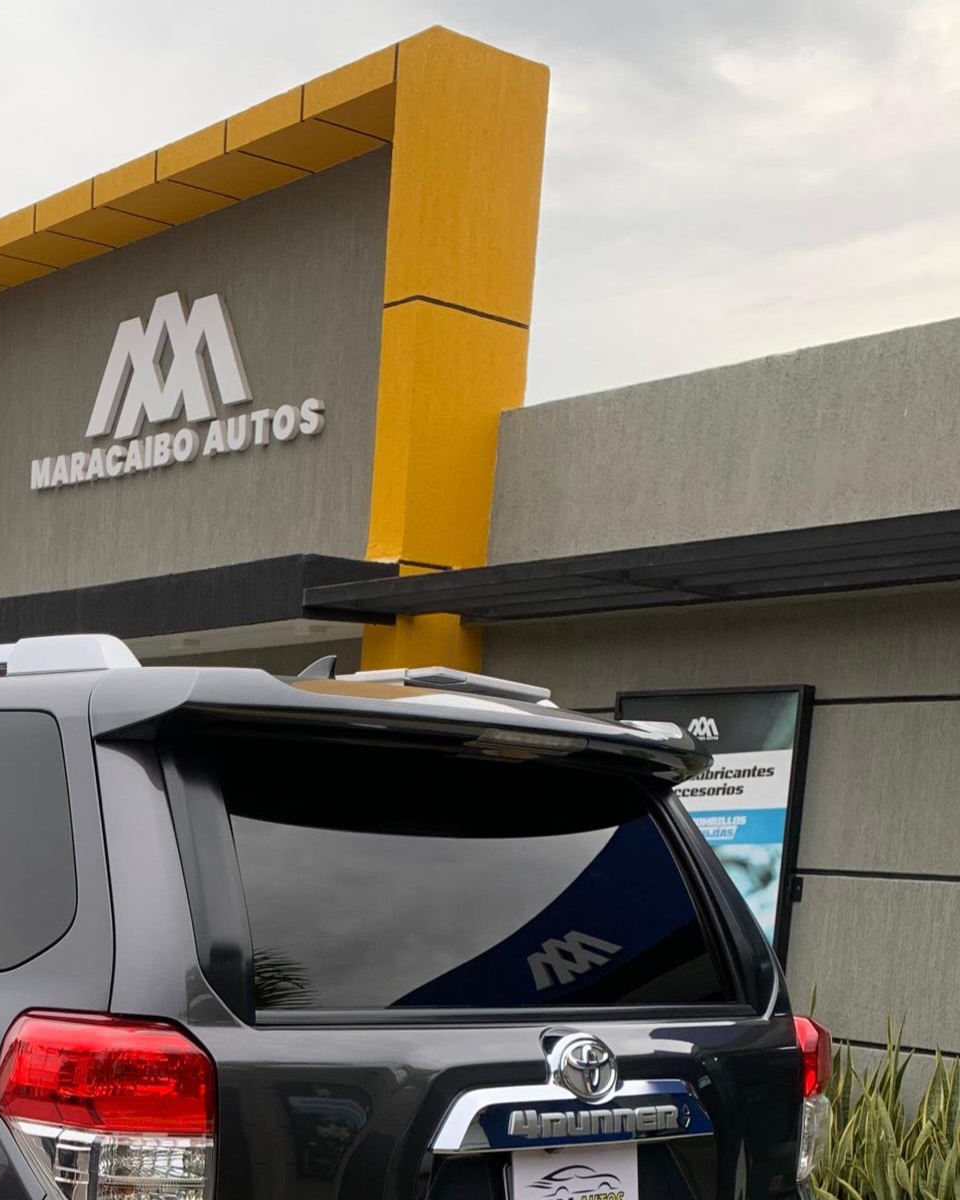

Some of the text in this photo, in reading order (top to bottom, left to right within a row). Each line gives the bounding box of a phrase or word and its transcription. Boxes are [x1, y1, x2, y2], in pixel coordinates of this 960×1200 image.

[30, 398, 325, 490] MARACAIBO AUTOS
[690, 765, 775, 781] ubricantes
[508, 1104, 680, 1140] 4RUNNER
